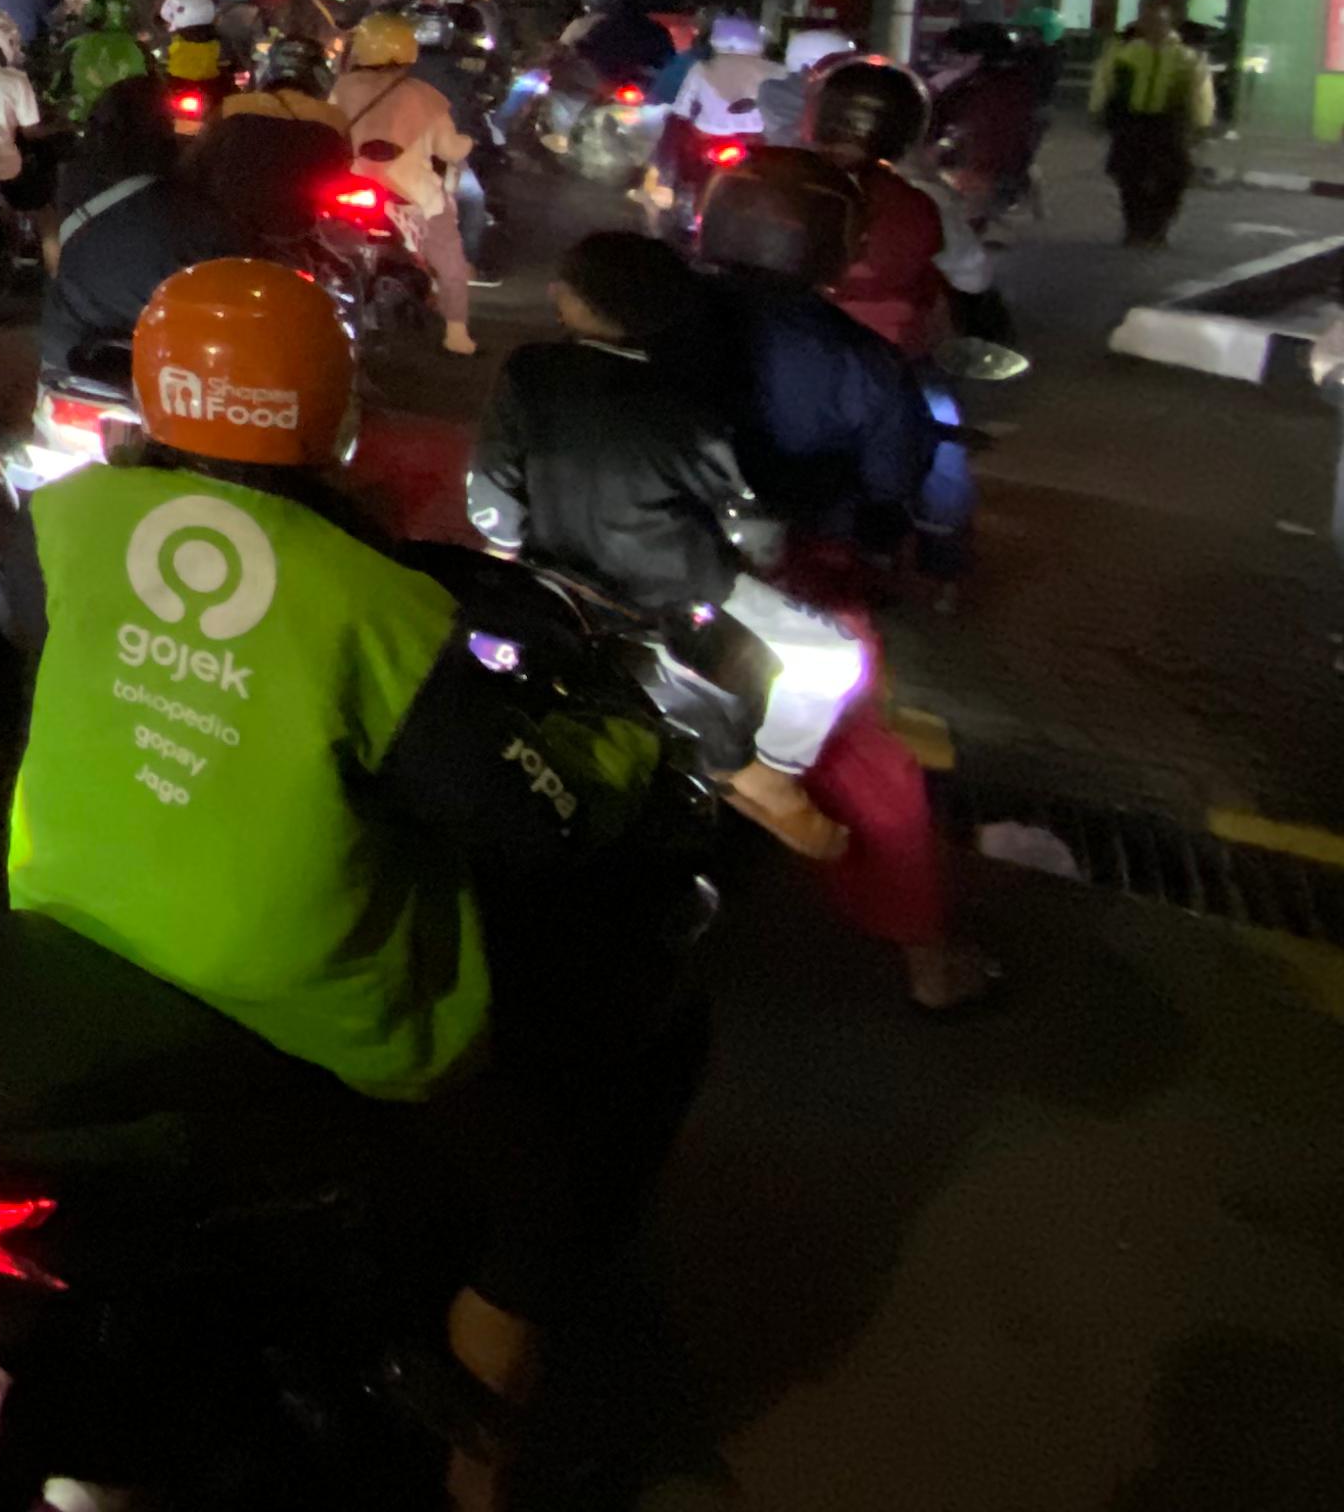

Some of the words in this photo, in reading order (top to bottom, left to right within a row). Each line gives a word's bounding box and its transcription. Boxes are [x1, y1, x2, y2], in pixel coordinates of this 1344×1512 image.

[207, 396, 299, 430] Food
[117, 622, 255, 699] gojek
[113, 679, 241, 746] tokopedia
[134, 724, 208, 776] gopay
